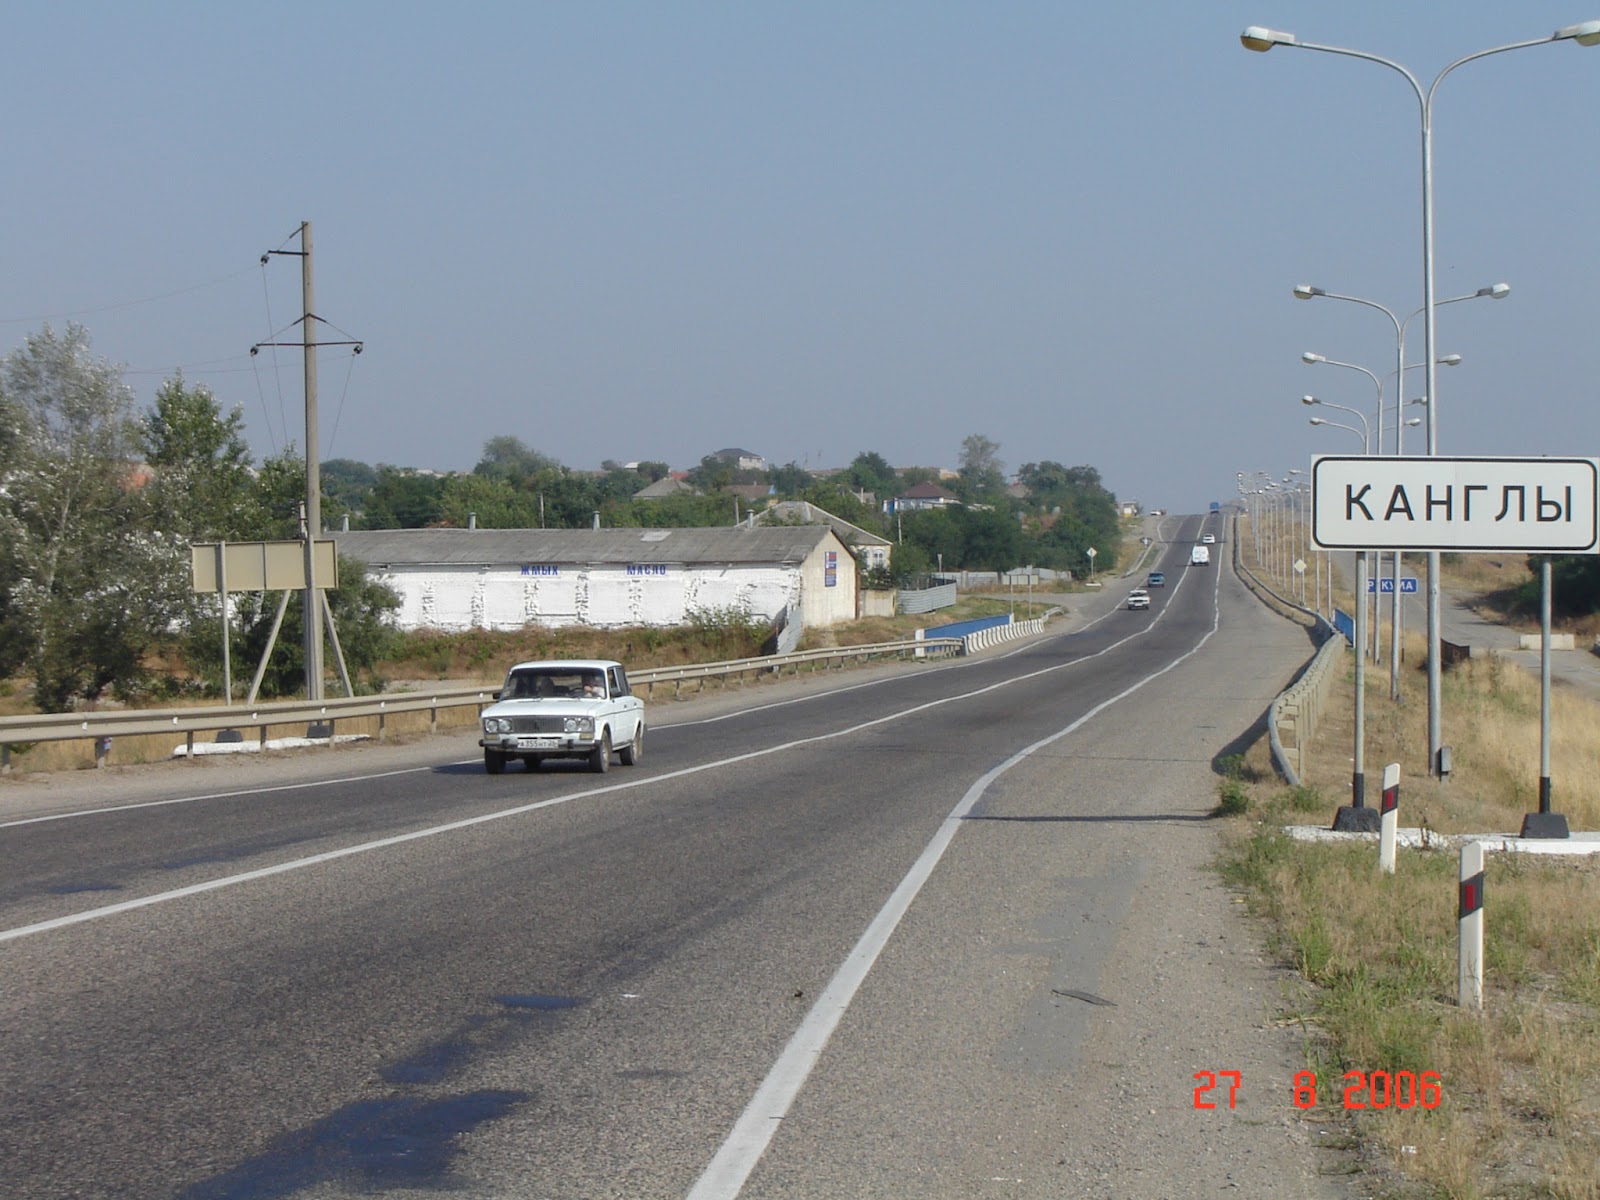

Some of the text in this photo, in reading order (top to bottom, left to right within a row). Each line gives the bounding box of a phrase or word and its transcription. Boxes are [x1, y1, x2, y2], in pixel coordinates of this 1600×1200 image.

[1346, 484, 1572, 522] КАНГЛЫ
[520, 565, 559, 576] ЖМЫХ
[626, 565, 666, 575] МАСЛО
